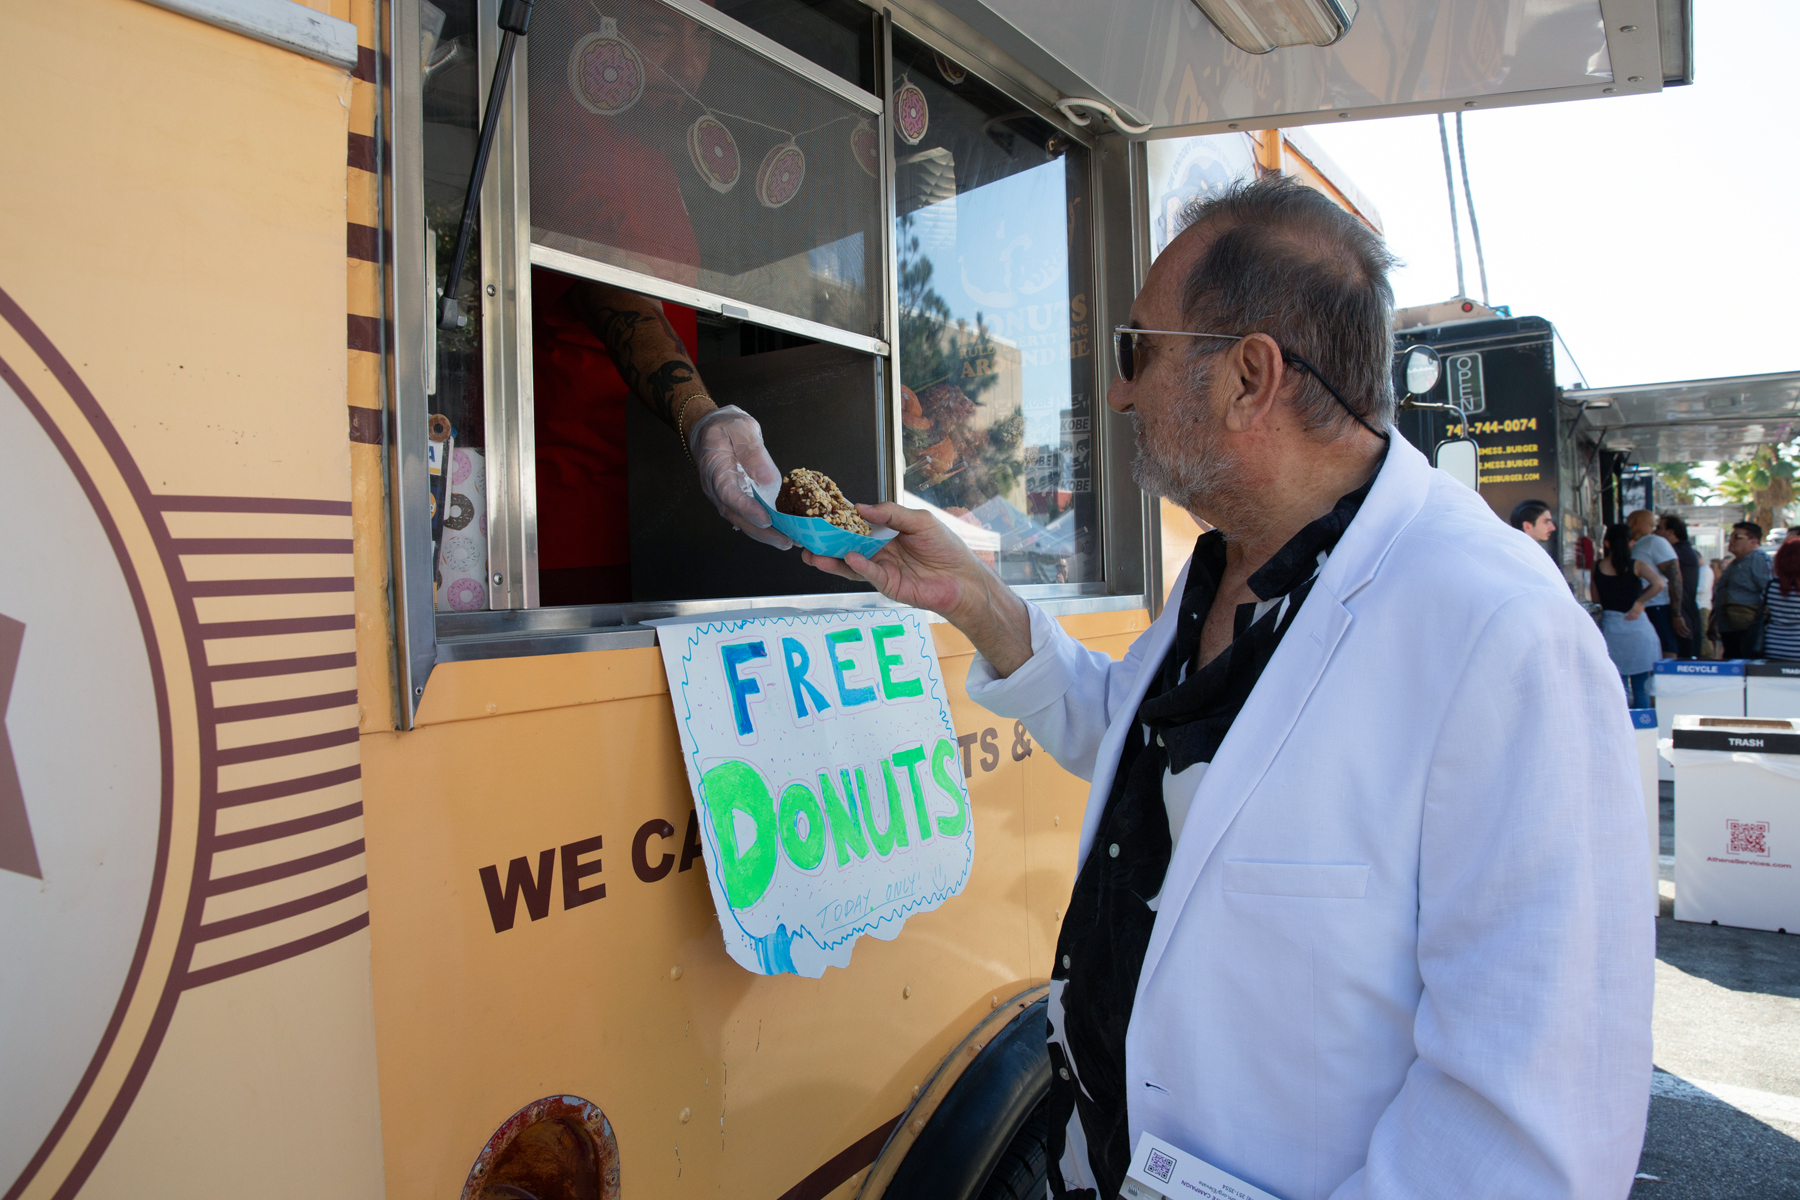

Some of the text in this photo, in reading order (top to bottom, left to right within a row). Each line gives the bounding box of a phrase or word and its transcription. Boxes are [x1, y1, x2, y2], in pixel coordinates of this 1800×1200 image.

[959, 293, 1088, 344] DONUTS
[960, 342, 996, 360] RULE
[960, 338, 1090, 380] AROUND ME
[1457, 357, 1474, 411] OPEN
[1060, 418, 1089, 431] KOBE
[1446, 418, 1537, 437] 74-744-0074
[1061, 480, 1090, 491] KOBE
[1677, 665, 1718, 673] RECYCLE
[721, 624, 924, 736] FREE
[1728, 738, 1764, 747] TRASH
[478, 834, 606, 934] WE
[1011, 719, 1033, 762] &
[702, 738, 966, 909] DONUTS
[1706, 856, 1792, 868] AthensServices.com
[816, 871, 921, 929] TODAY ONLY!
[1181, 1180, 1212, 1199] CAMPAIGN
